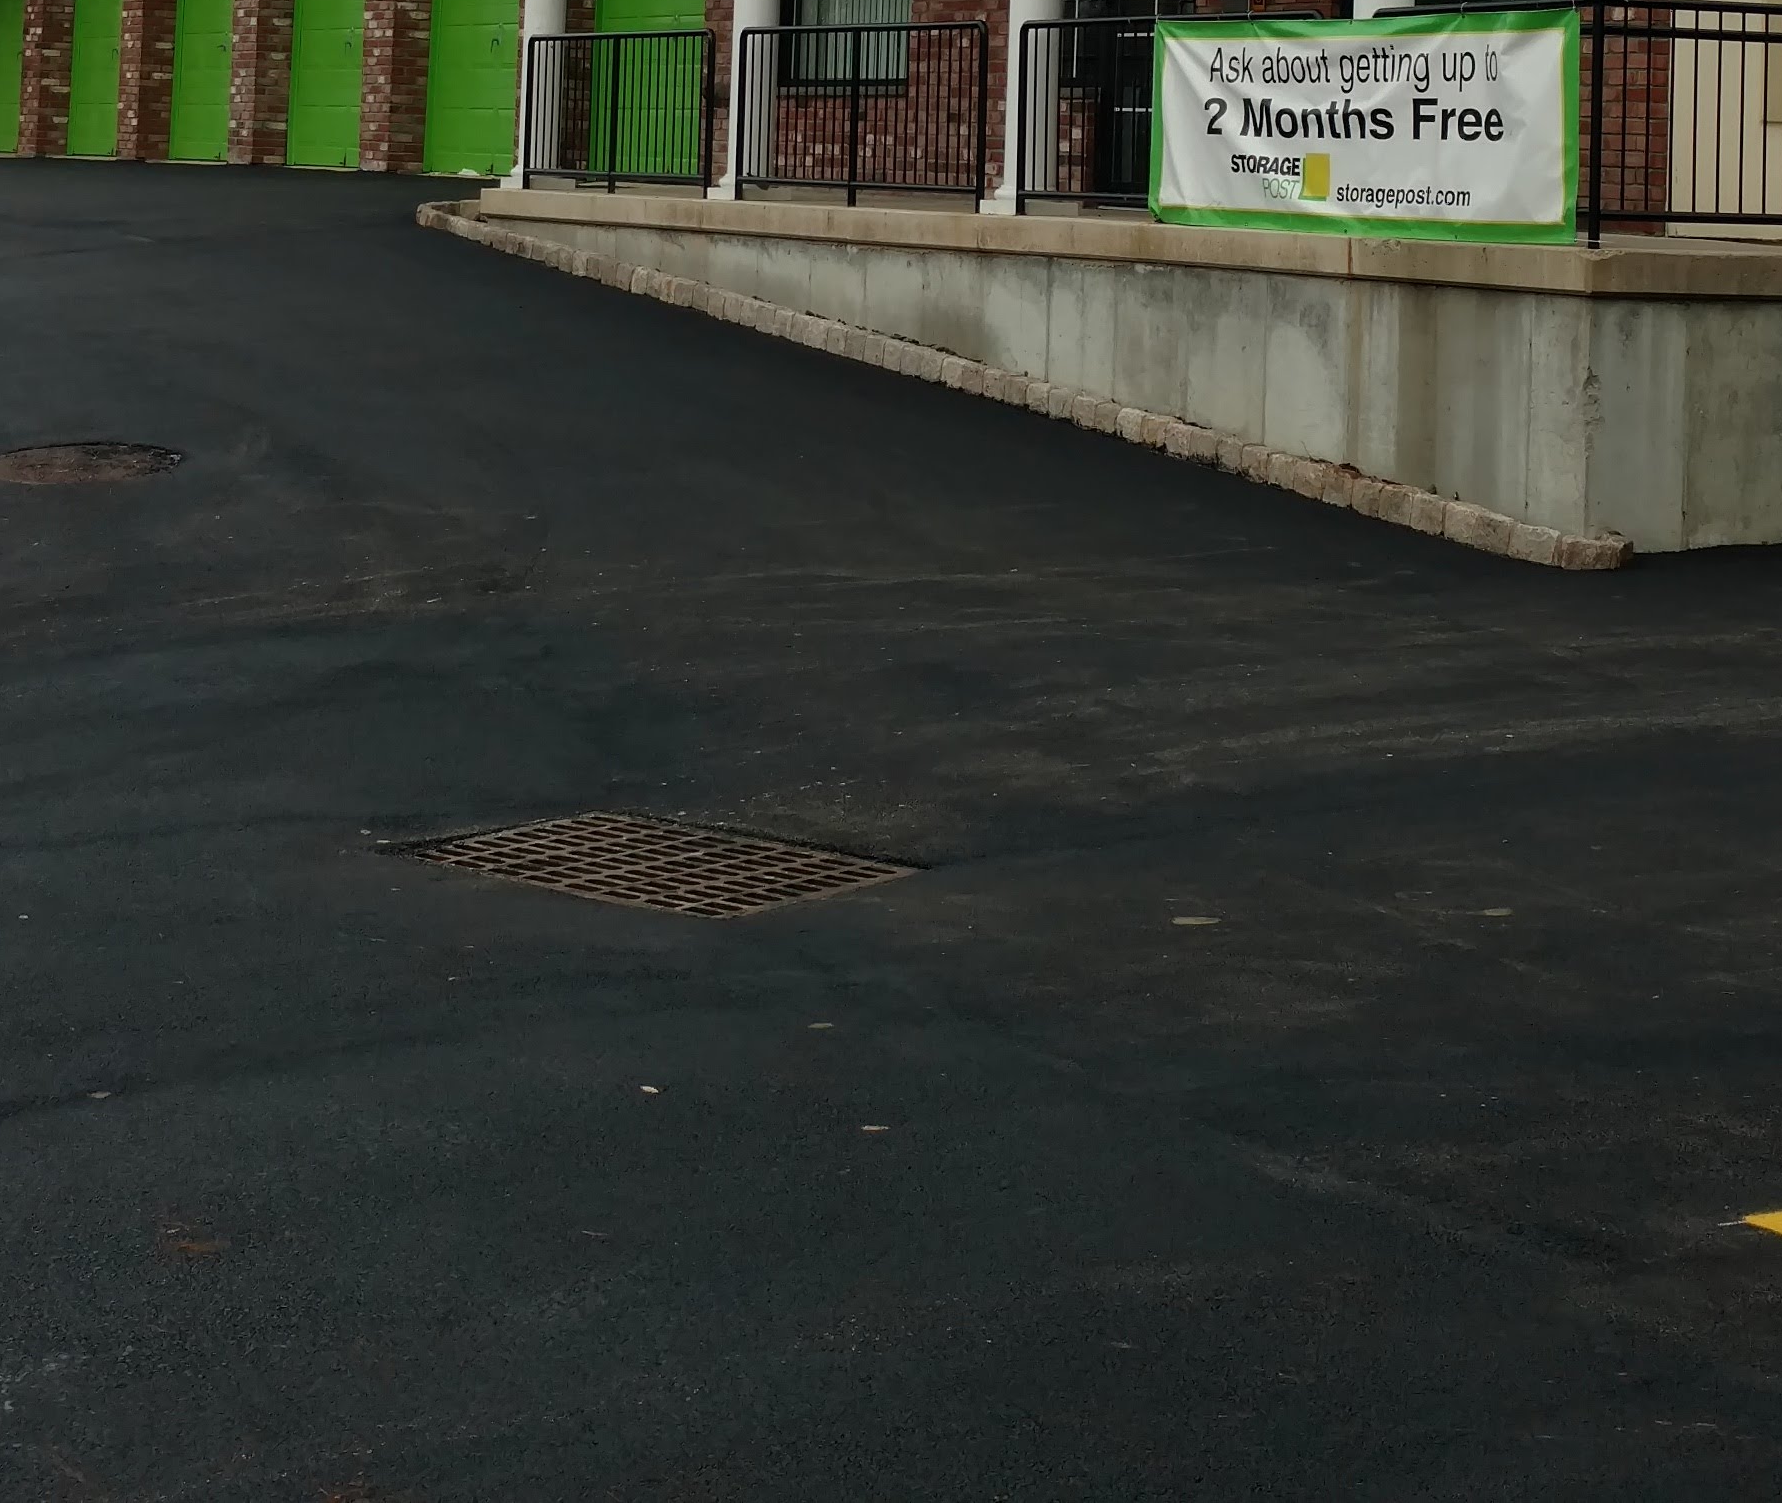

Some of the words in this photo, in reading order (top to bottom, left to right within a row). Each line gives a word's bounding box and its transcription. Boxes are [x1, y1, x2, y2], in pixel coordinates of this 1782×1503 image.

[1209, 46, 1255, 84] Ask
[1262, 45, 1331, 85] about
[1340, 44, 1431, 94] getting
[1442, 50, 1476, 92] up
[1484, 43, 1499, 82] to
[1204, 97, 1228, 136] 2
[1239, 97, 1394, 140] Months
[1412, 98, 1505, 142] Free
[1230, 153, 1301, 177] STORAGE
[1263, 179, 1300, 200] POST
[1335, 182, 1471, 210] storagepost.com
